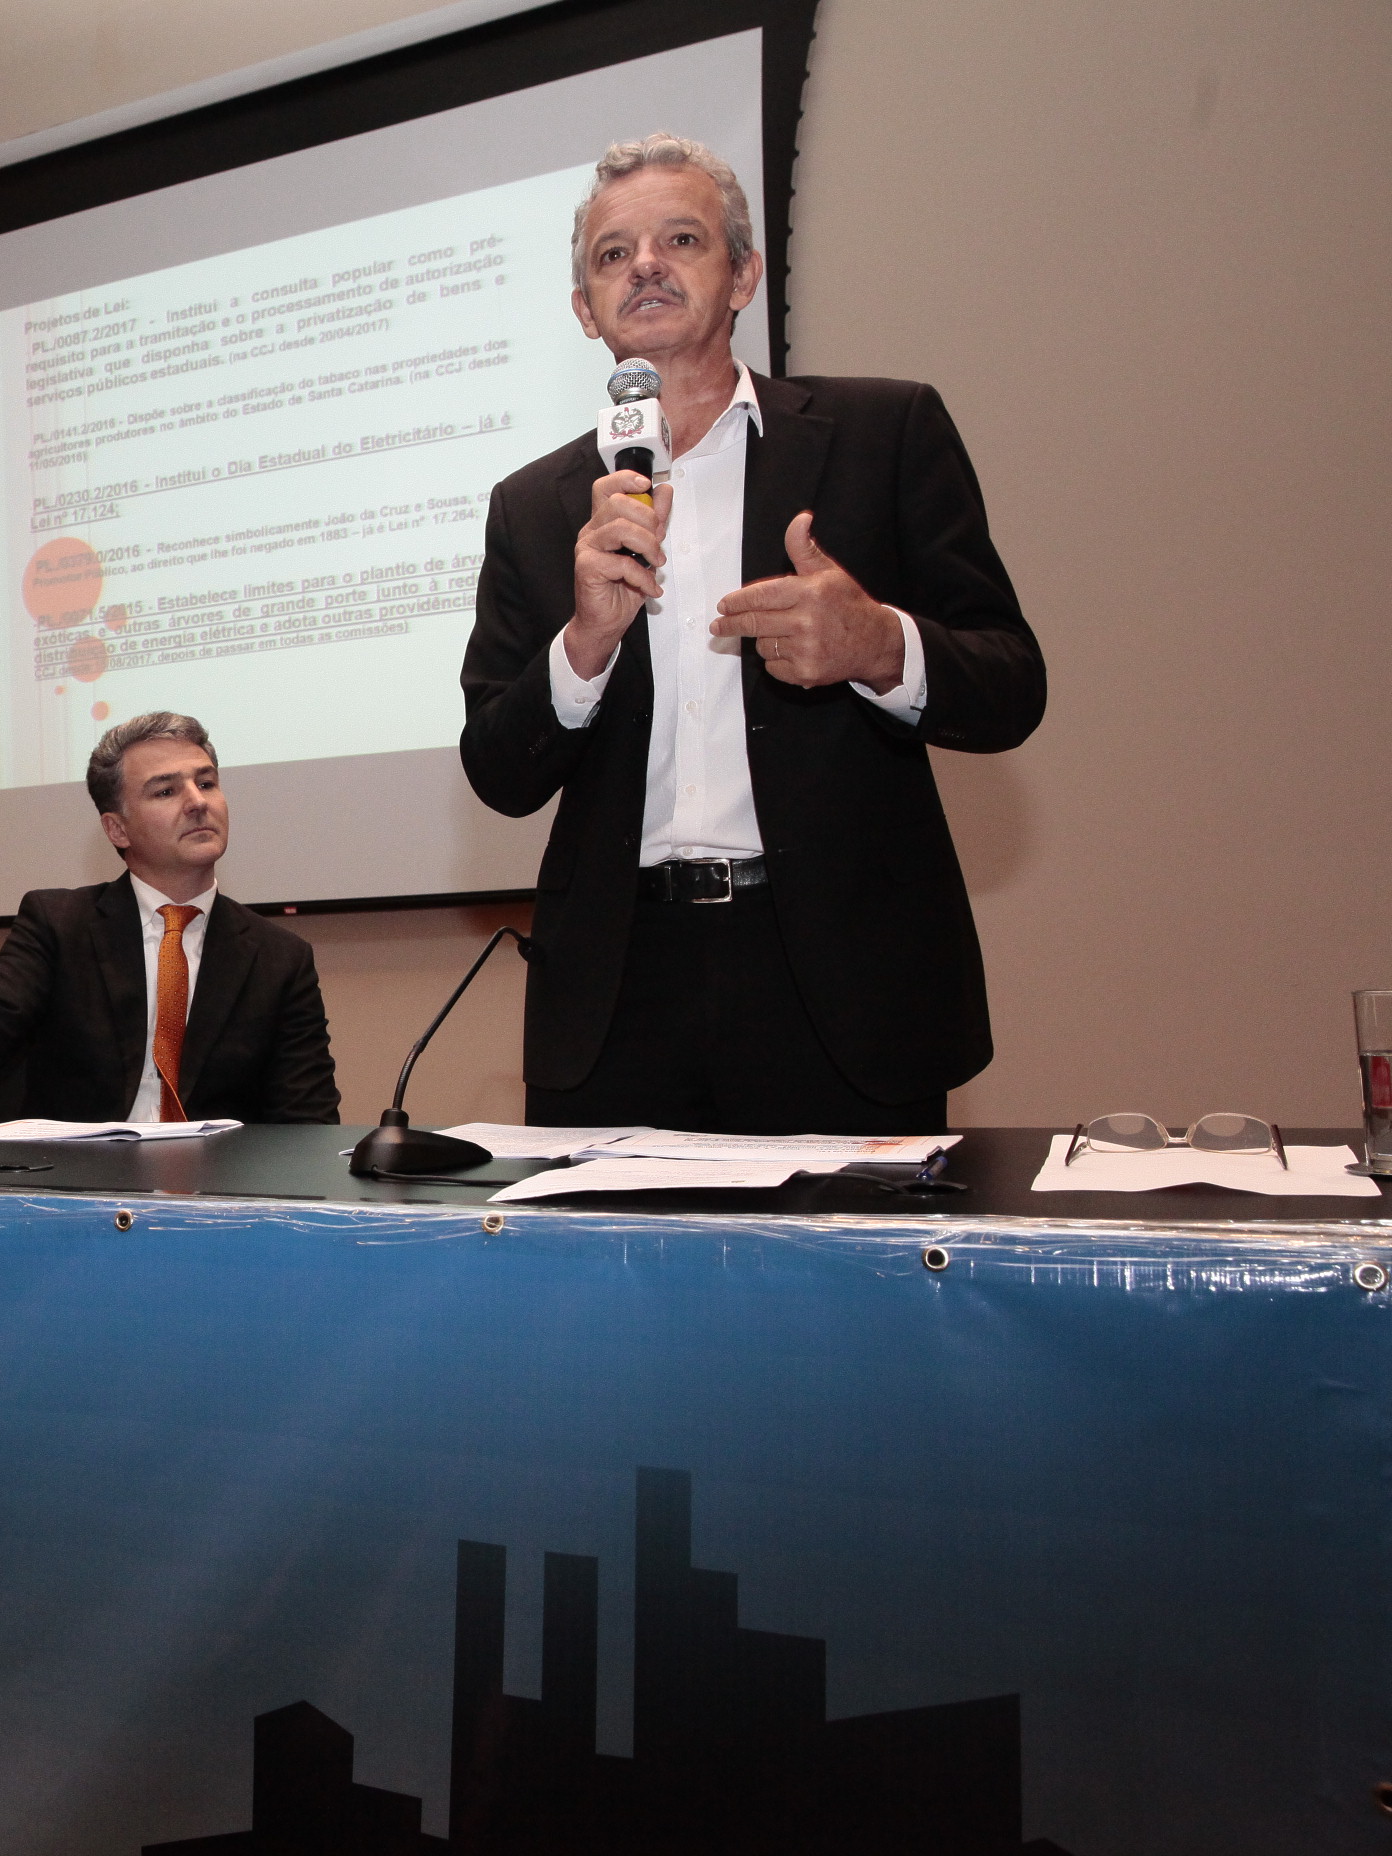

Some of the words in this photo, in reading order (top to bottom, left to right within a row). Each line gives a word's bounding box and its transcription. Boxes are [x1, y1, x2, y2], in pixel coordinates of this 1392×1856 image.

[24, 310, 80, 337] Projetos
[83, 305, 100, 320] de
[104, 297, 130, 315] Lei:
[25, 348, 85, 375] requisito
[90, 342, 121, 361] para
[125, 339, 133, 350] a
[139, 318, 215, 349] tramitação
[221, 317, 229, 328] e
[235, 314, 244, 325] o
[251, 282, 373, 324] processamento
[378, 275, 399, 293] de
[405, 250, 504, 289] autorização
[32, 318, 137, 355] PL./0087.2/2017
[166, 299, 216, 323] Institui
[229, 296, 239, 308] a
[251, 275, 317, 303] consulta
[331, 257, 393, 287] popular
[407, 246, 454, 267] como
[469, 230, 503, 255] pré-
[26, 363, 94, 393] legislativa
[103, 358, 131, 375] que
[141, 337, 209, 367] disponha
[220, 325, 263, 347] sobre
[275, 323, 285, 335] a
[296, 295, 394, 333] privatização
[405, 288, 426, 306] de
[440, 276, 481, 298] bens
[494, 273, 505, 286] e
[26, 383, 82, 409] serviços
[86, 368, 147, 397] públicos
[149, 352, 224, 380] estaduais.
[228, 347, 247, 365] (na
[250, 342, 274, 358] CCJ
[278, 333, 315, 352] desde
[319, 317, 389, 345] 20/04/2017)
[28, 436, 90, 461] agricultores
[94, 423, 155, 448] produtores
[159, 421, 173, 432] no
[178, 409, 218, 429] âmbito
[222, 406, 237, 419] do
[242, 396, 283, 415] Estado
[288, 393, 302, 406] de
[307, 384, 342, 403] Santa
[347, 372, 403, 395] Catarina.
[408, 367, 429, 385] (na
[435, 360, 463, 377] CCJ
[467, 351, 508, 371] desde
[127, 406, 165, 427] Dispõe
[169, 399, 201, 416] sobre
[216, 380, 294, 409] classificação
[298, 376, 313, 390] do
[317, 366, 359, 386] tabaco
[364, 363, 387, 376] nas
[391, 342, 478, 374] propriedades
[483, 336, 508, 352] dos
[154, 466, 205, 488] Institui
[211, 467, 220, 478] o
[227, 458, 252, 475] Dia
[258, 443, 325, 470] Estadual
[331, 438, 353, 456] do
[359, 419, 454, 451] Eletricitário
[477, 412, 493, 433] já
[500, 408, 511, 426] é
[30, 514, 50, 530] Lei
[130, 562, 143, 572] ao
[146, 553, 184, 570] direito
[186, 552, 208, 566] que
[210, 546, 228, 560] lhe
[230, 543, 247, 556] foi
[249, 536, 294, 556] negado
[296, 535, 315, 546] em
[361, 523, 374, 538] já
[376, 521, 385, 533] é
[388, 517, 410, 531] Lei
[156, 532, 220, 554] Reconhece
[224, 516, 319, 543] simbolicamente
[325, 510, 354, 527] João
[359, 507, 375, 521] da
[379, 501, 410, 518] Cruz
[426, 491, 471, 512] Sousa,
[33, 626, 90, 646] exóticas
[98, 627, 106, 637] e
[114, 618, 159, 635] outras
[167, 607, 223, 628] árvores
[232, 603, 251, 619] de
[260, 594, 315, 618] grande
[325, 588, 367, 609] porte
[376, 579, 419, 601] junto
[448, 571, 479, 589] red
[157, 586, 237, 611] Estabelece
[243, 578, 294, 598] limites
[301, 575, 335, 593] para
[342, 572, 353, 584] o
[359, 559, 418, 585] plantio
[423, 555, 444, 573] de
[34, 666, 55, 678] CCJ
[157, 647, 196, 664] depois
[198, 645, 212, 657] de
[215, 642, 254, 657] passar
[258, 639, 276, 649] em
[279, 632, 313, 647] todas
[317, 631, 333, 642] as
[119, 637, 137, 653] de
[141, 630, 195, 652] energia
[199, 621, 254, 642] elétrica
[259, 622, 268, 633] e
[273, 612, 317, 631] adota
[321, 606, 373, 625] outras
[378, 591, 476, 620] providência
